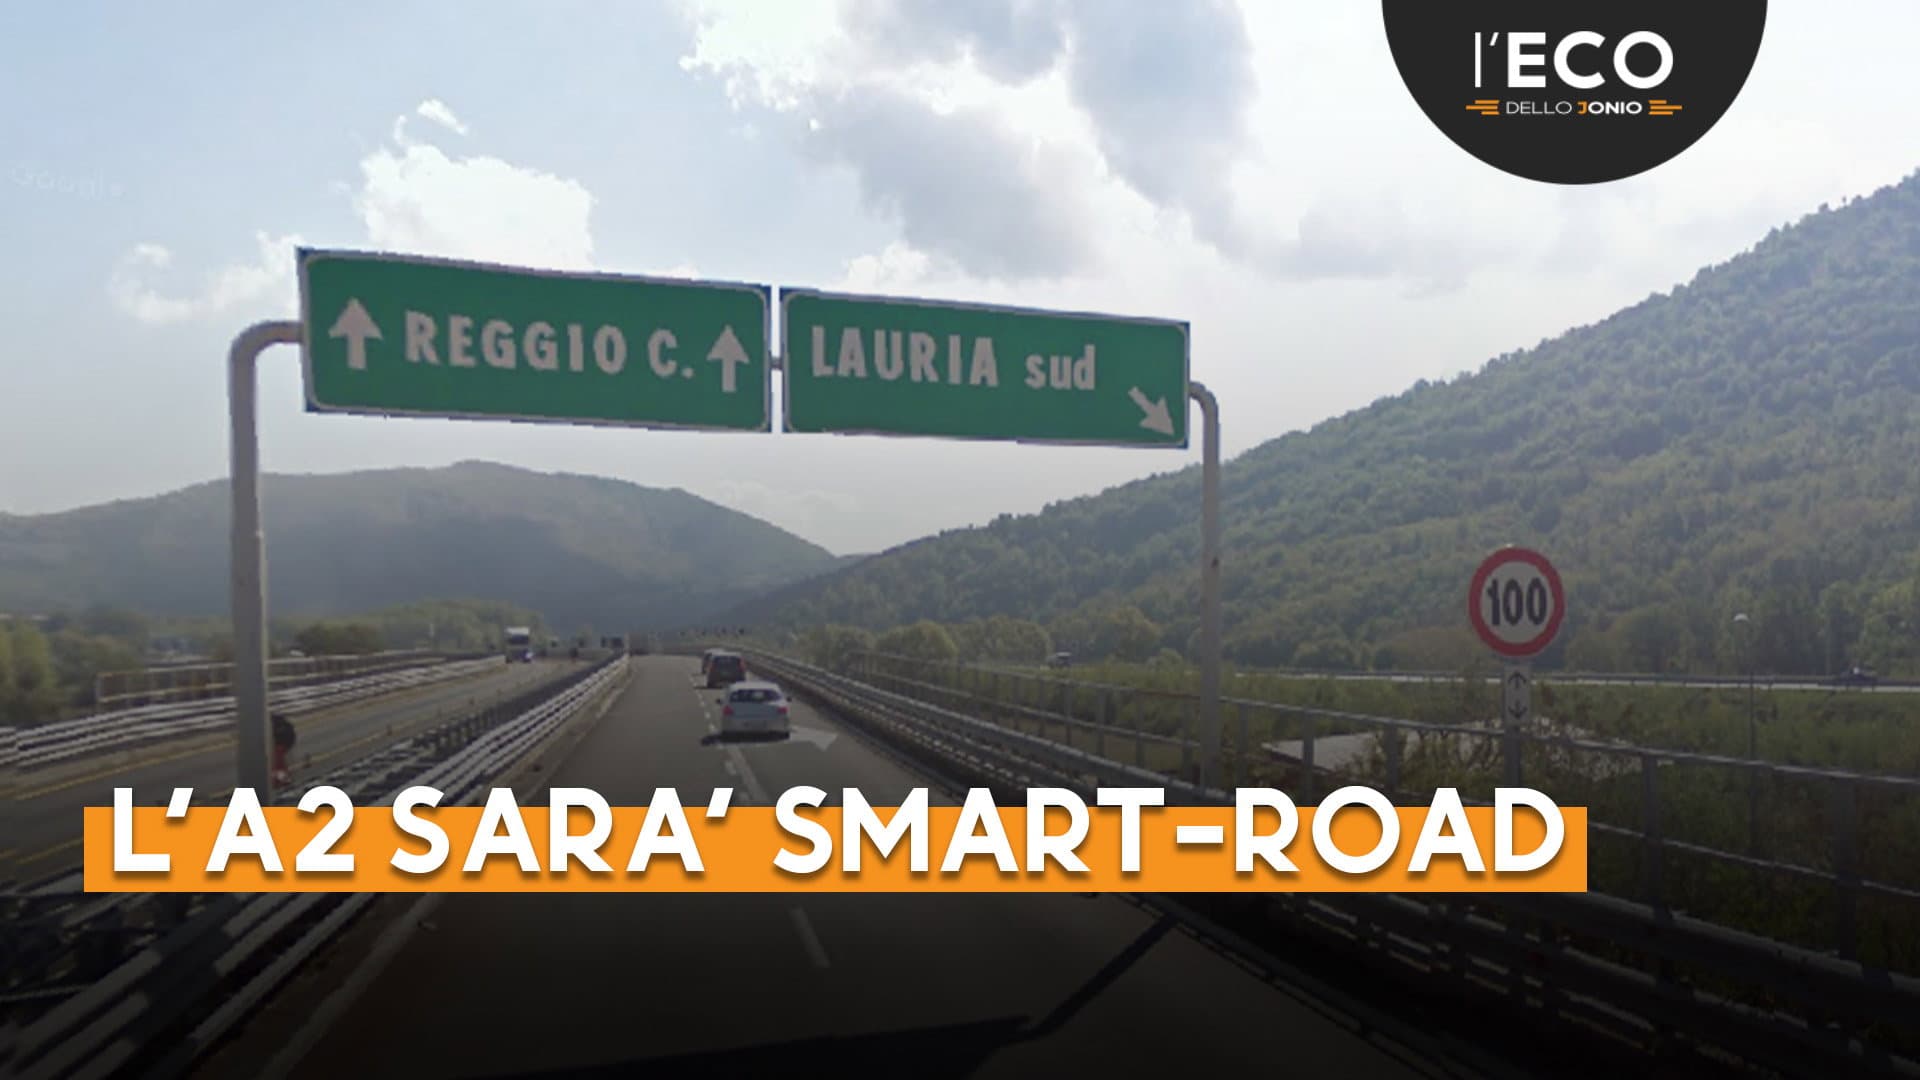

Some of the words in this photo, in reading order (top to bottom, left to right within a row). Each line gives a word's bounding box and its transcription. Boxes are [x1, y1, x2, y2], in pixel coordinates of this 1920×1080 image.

[404, 310, 627, 375] REGGIO
[648, 329, 695, 378] C.
[811, 325, 999, 387] LAURIA
[1024, 344, 1096, 391] sud
[1487, 577, 1548, 627] 100
